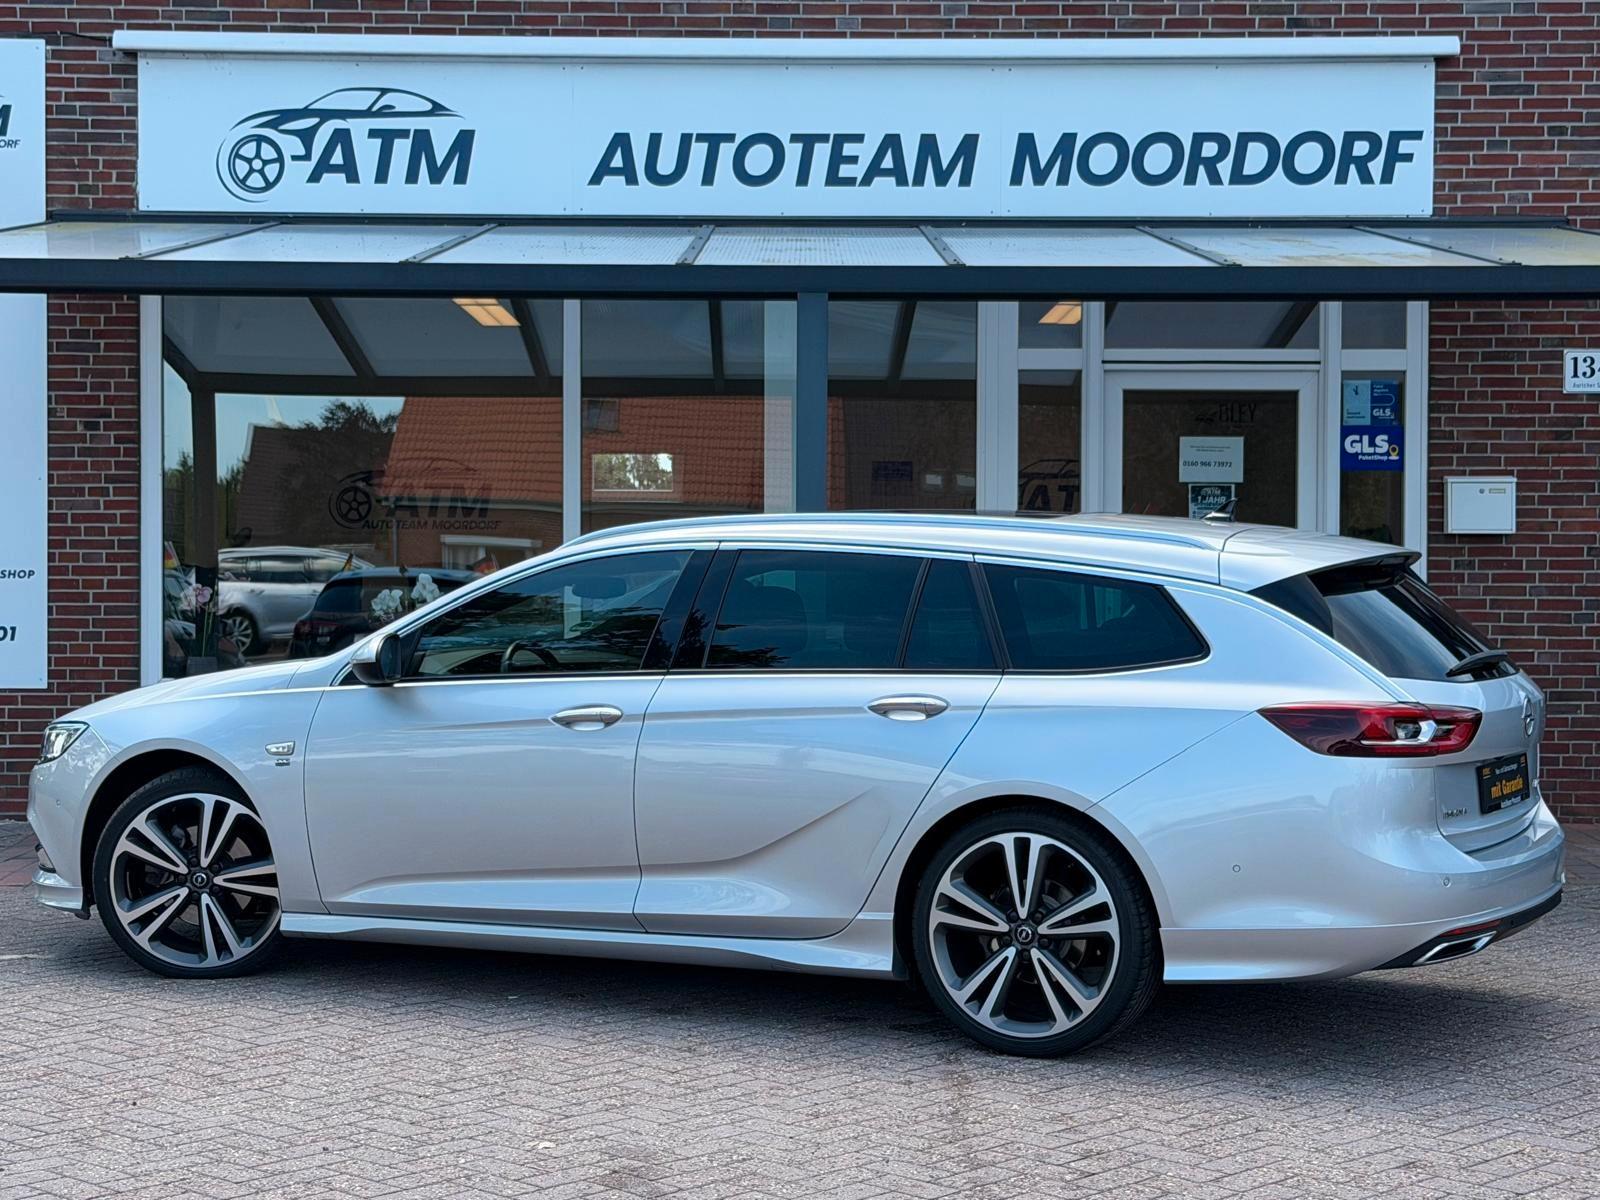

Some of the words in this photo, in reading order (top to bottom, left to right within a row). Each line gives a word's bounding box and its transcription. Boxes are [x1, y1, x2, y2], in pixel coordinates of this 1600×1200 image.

[305, 127, 476, 185] ATM
[587, 132, 980, 187] AUTOTEAM
[1009, 130, 1425, 187] MOORDORF
[1570, 355, 1600, 379] 13
[1372, 408, 1391, 417] GLS
[1344, 434, 1390, 454] GLS
[385, 483, 492, 518] ATM
[1025, 484, 1082, 512] AT
[1202, 496, 1226, 504] JAHR
[361, 519, 429, 531] AUTOTEAM
[431, 519, 503, 531] MOORDORF
